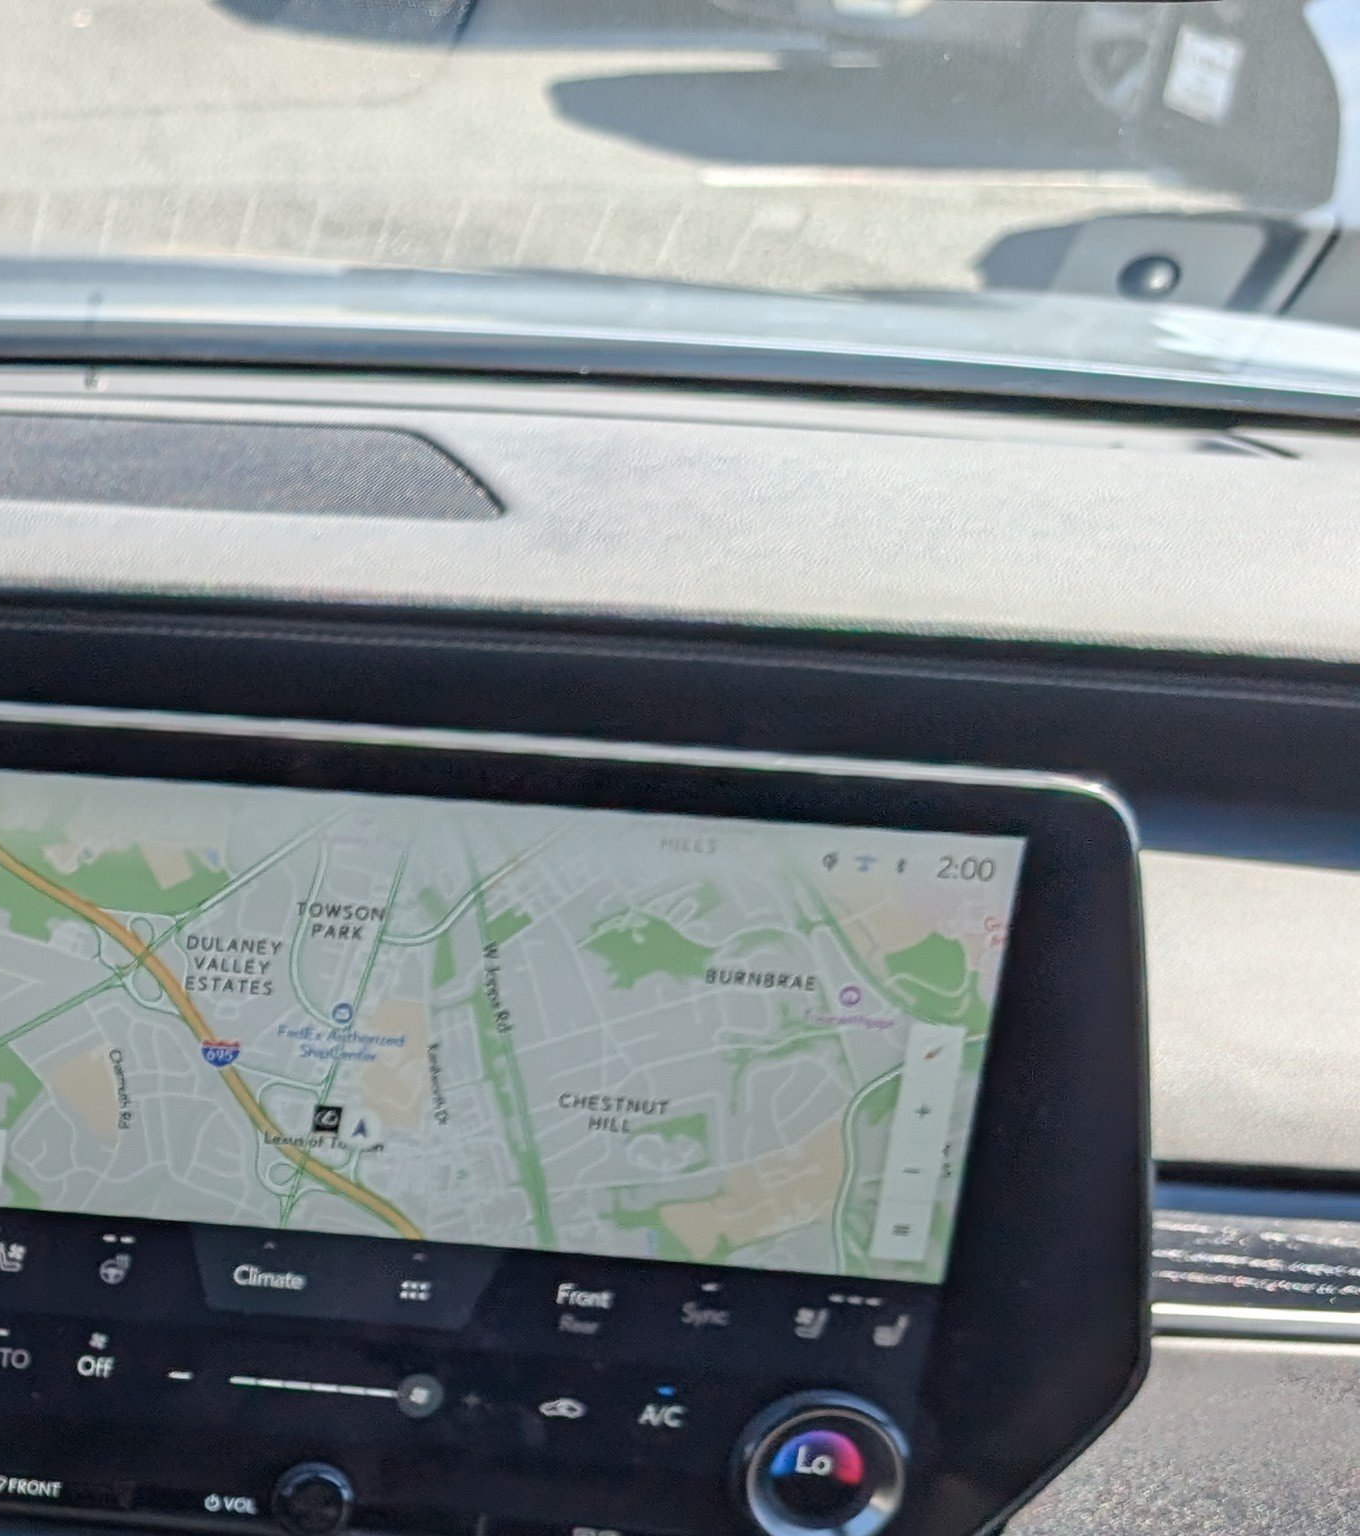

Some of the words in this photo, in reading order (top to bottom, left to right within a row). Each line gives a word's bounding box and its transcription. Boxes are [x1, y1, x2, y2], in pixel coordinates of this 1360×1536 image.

[936, 856, 997, 882] 2:00
[297, 901, 387, 921] TOWSON
[311, 923, 363, 940] PARK
[186, 934, 283, 956] DULANEY
[194, 956, 271, 975] VALLEY
[185, 975, 273, 996] ESTATES
[705, 967, 817, 992] BURNBRAE
[558, 1091, 669, 1115] CHESTNUT
[588, 1116, 630, 1133] HILL
[232, 1264, 307, 1291] Climate
[556, 1282, 614, 1309] Front
[76, 1355, 116, 1378] Off
[637, 1403, 685, 1429] A/C
[795, 1446, 833, 1477] Lo
[7, 1478, 62, 1498] FRONT
[224, 1496, 258, 1516] VOL
